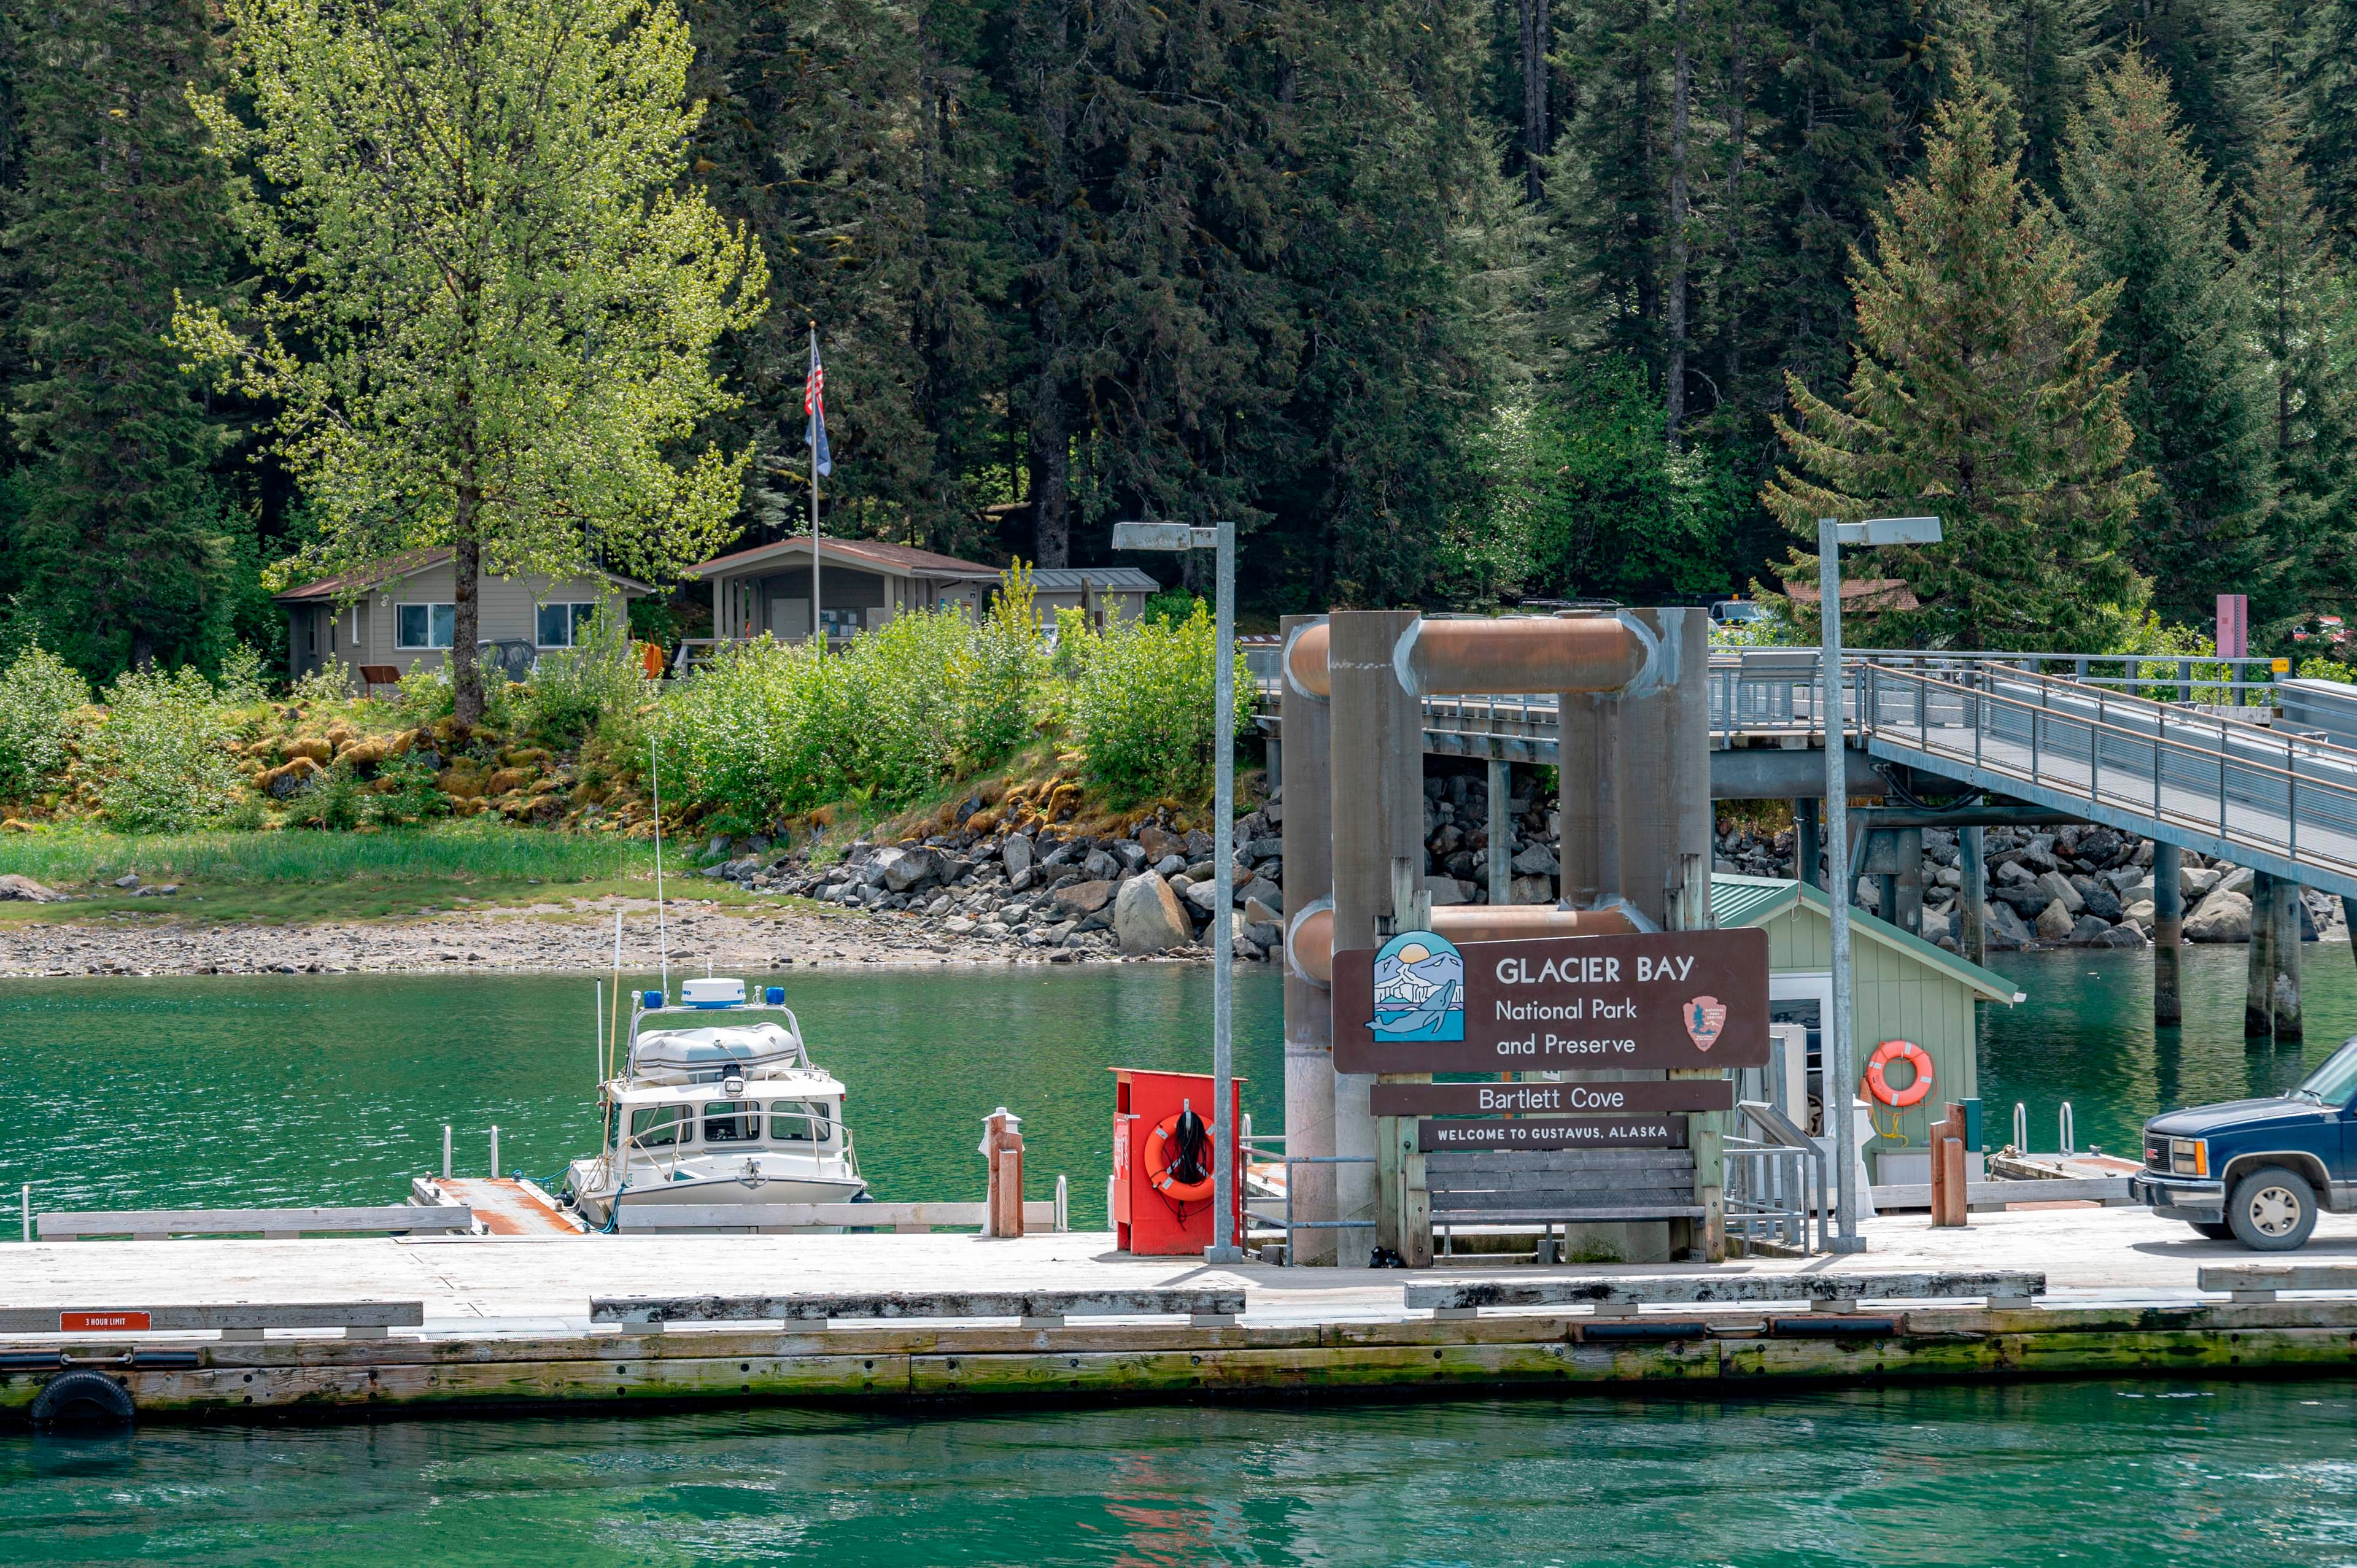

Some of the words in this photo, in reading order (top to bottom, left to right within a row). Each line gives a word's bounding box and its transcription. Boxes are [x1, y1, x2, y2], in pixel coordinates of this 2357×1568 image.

[1496, 957, 1620, 984] GLACIER
[1637, 956, 1695, 982] BAY
[1496, 998, 1582, 1020] National
[1592, 997, 1637, 1019] Park
[1496, 1033, 1535, 1055] and
[1546, 1033, 1636, 1054] Preserve
[1479, 1089, 1560, 1109] Bartlett
[1571, 1087, 1624, 1108] Cove
[1438, 1129, 1505, 1141] WELCOME
[1509, 1128, 1527, 1140] TO
[1609, 1126, 1667, 1138] ALASKA
